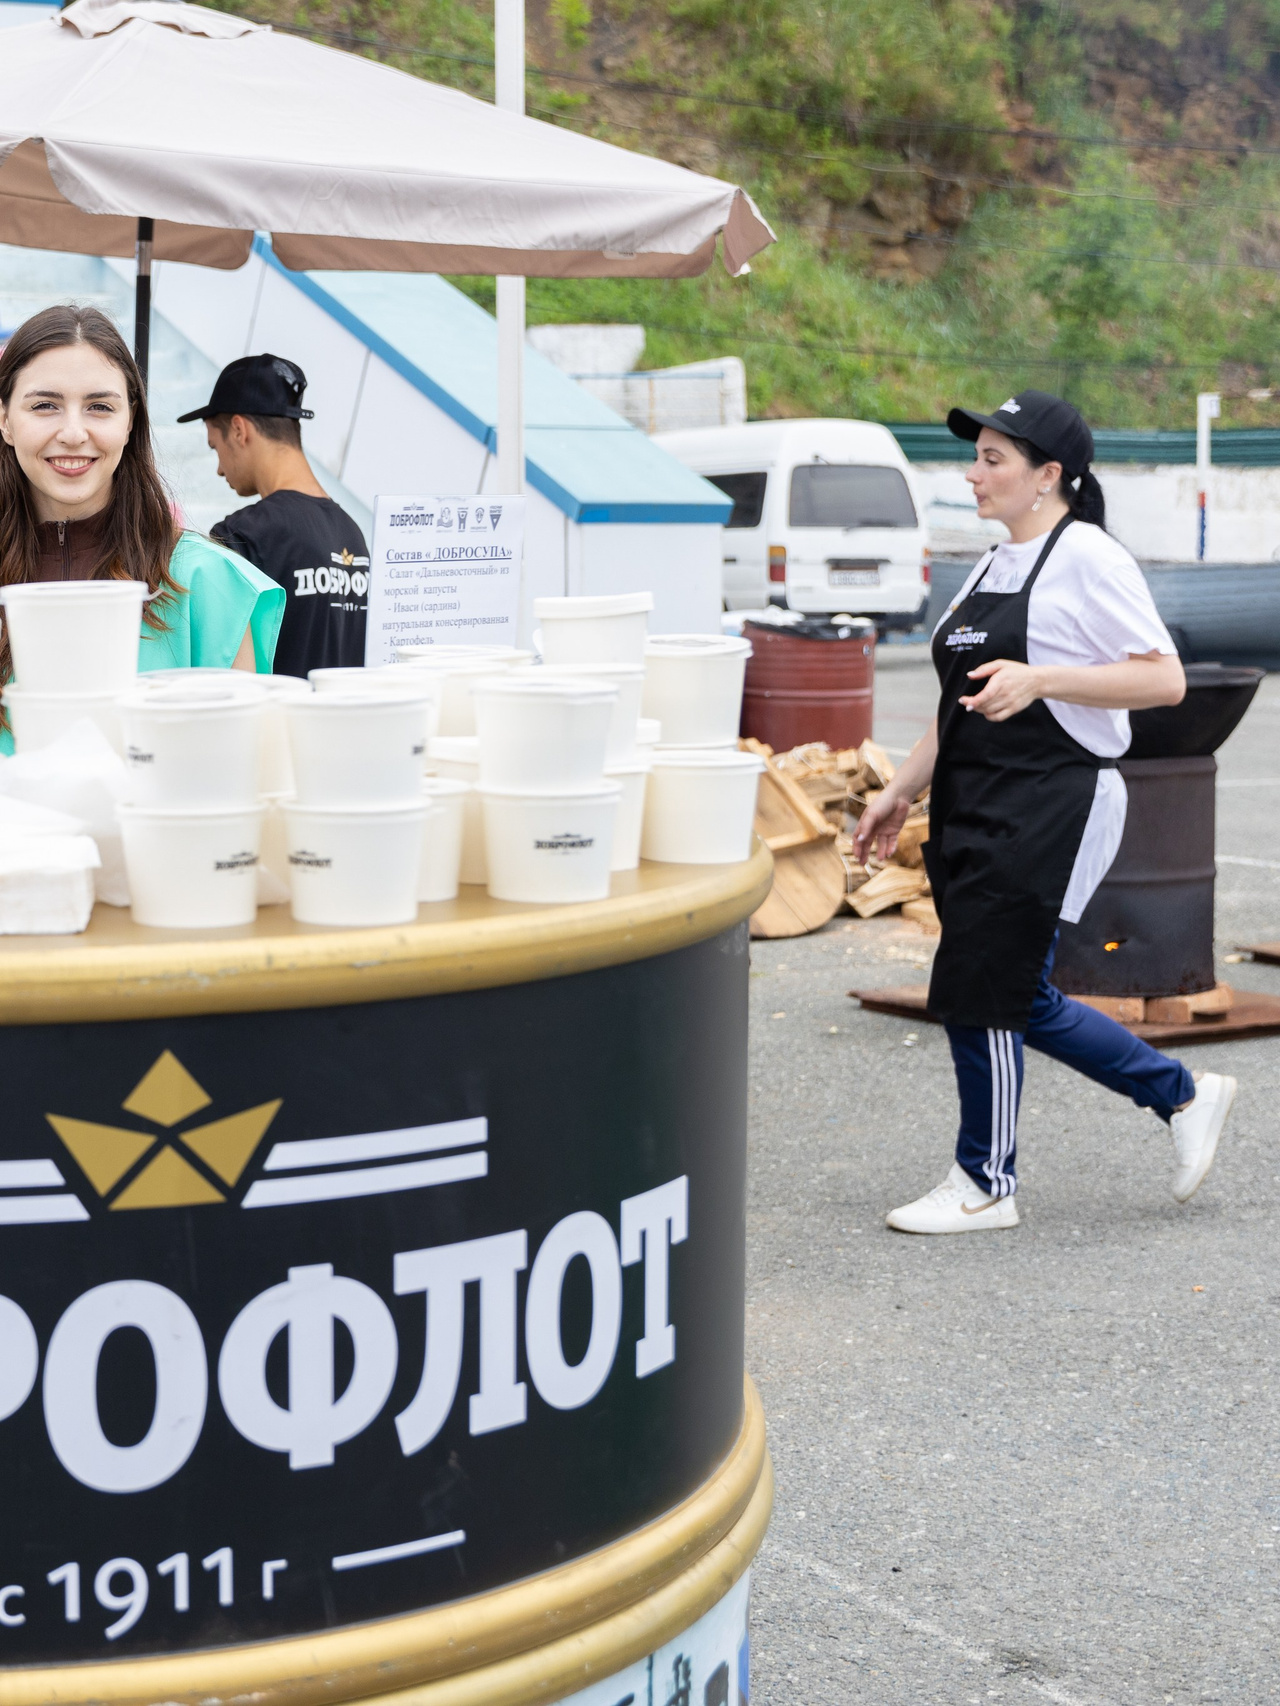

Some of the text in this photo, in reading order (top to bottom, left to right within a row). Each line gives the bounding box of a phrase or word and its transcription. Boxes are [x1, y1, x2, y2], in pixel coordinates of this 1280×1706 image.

[389, 513, 434, 527] ДОБРОФЛОТ
[386, 548, 422, 561] Состав
[389, 568, 414, 579] Салат
[416, 565, 498, 579] «Дальневосточный»
[500, 566, 510, 575] из
[384, 585, 458, 599] морской капусты
[393, 602, 419, 613] Иваси
[421, 600, 461, 614] (сардина)
[382, 616, 509, 632] натуральная консервированная
[389, 634, 435, 647] Картофель
